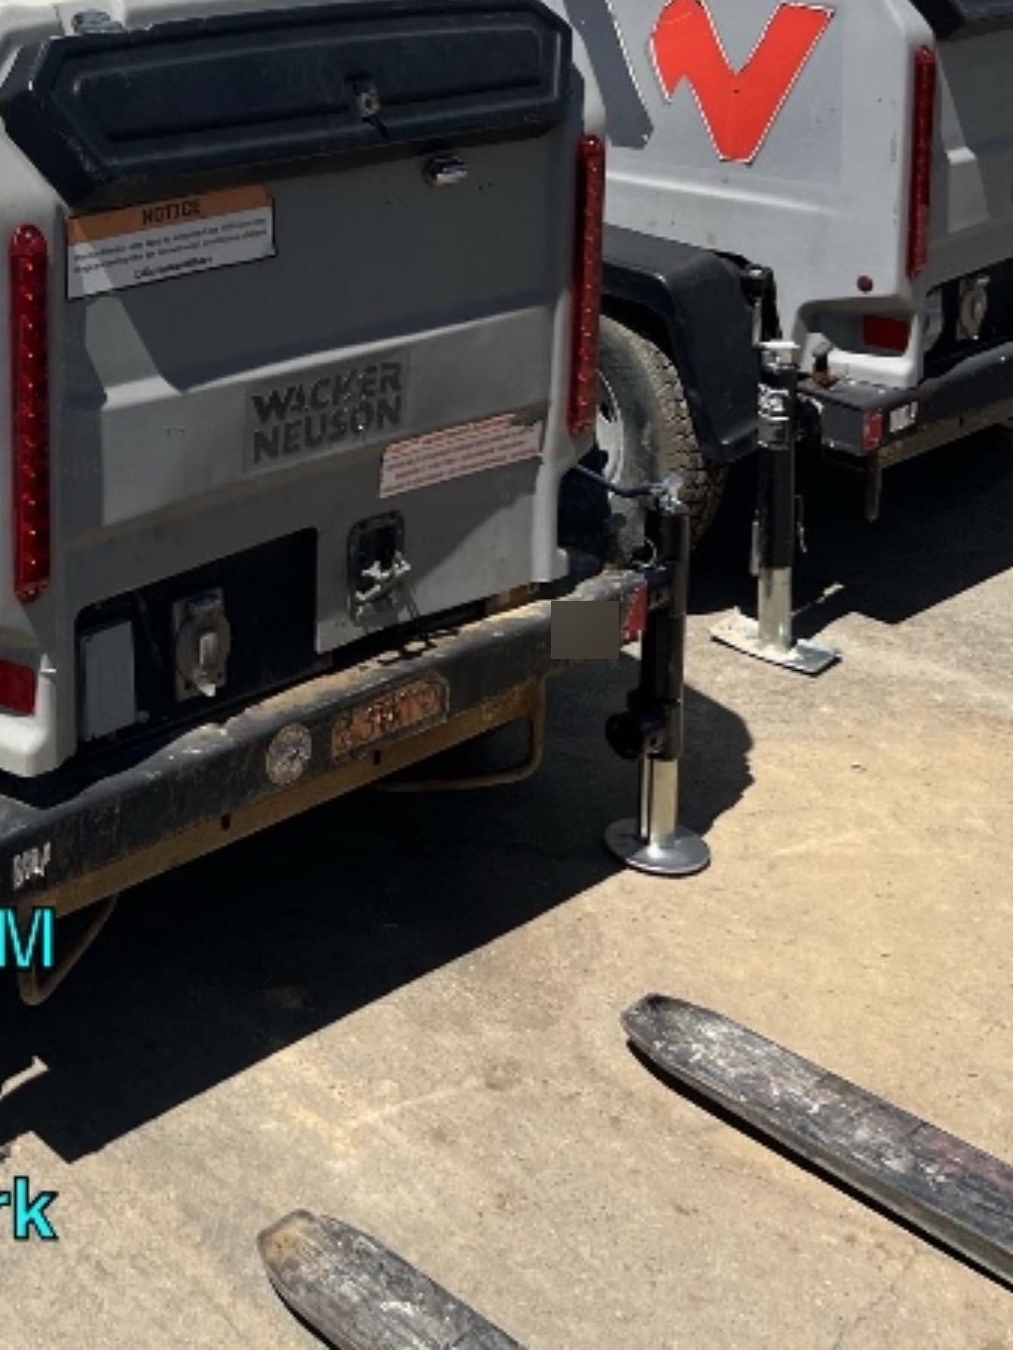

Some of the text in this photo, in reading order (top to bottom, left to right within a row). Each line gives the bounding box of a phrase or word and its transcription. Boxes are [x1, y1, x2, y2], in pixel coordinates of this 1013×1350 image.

[141, 198, 202, 226] NOTICE
[251, 361, 403, 424] WACKER
[253, 395, 402, 466] NEUSON
